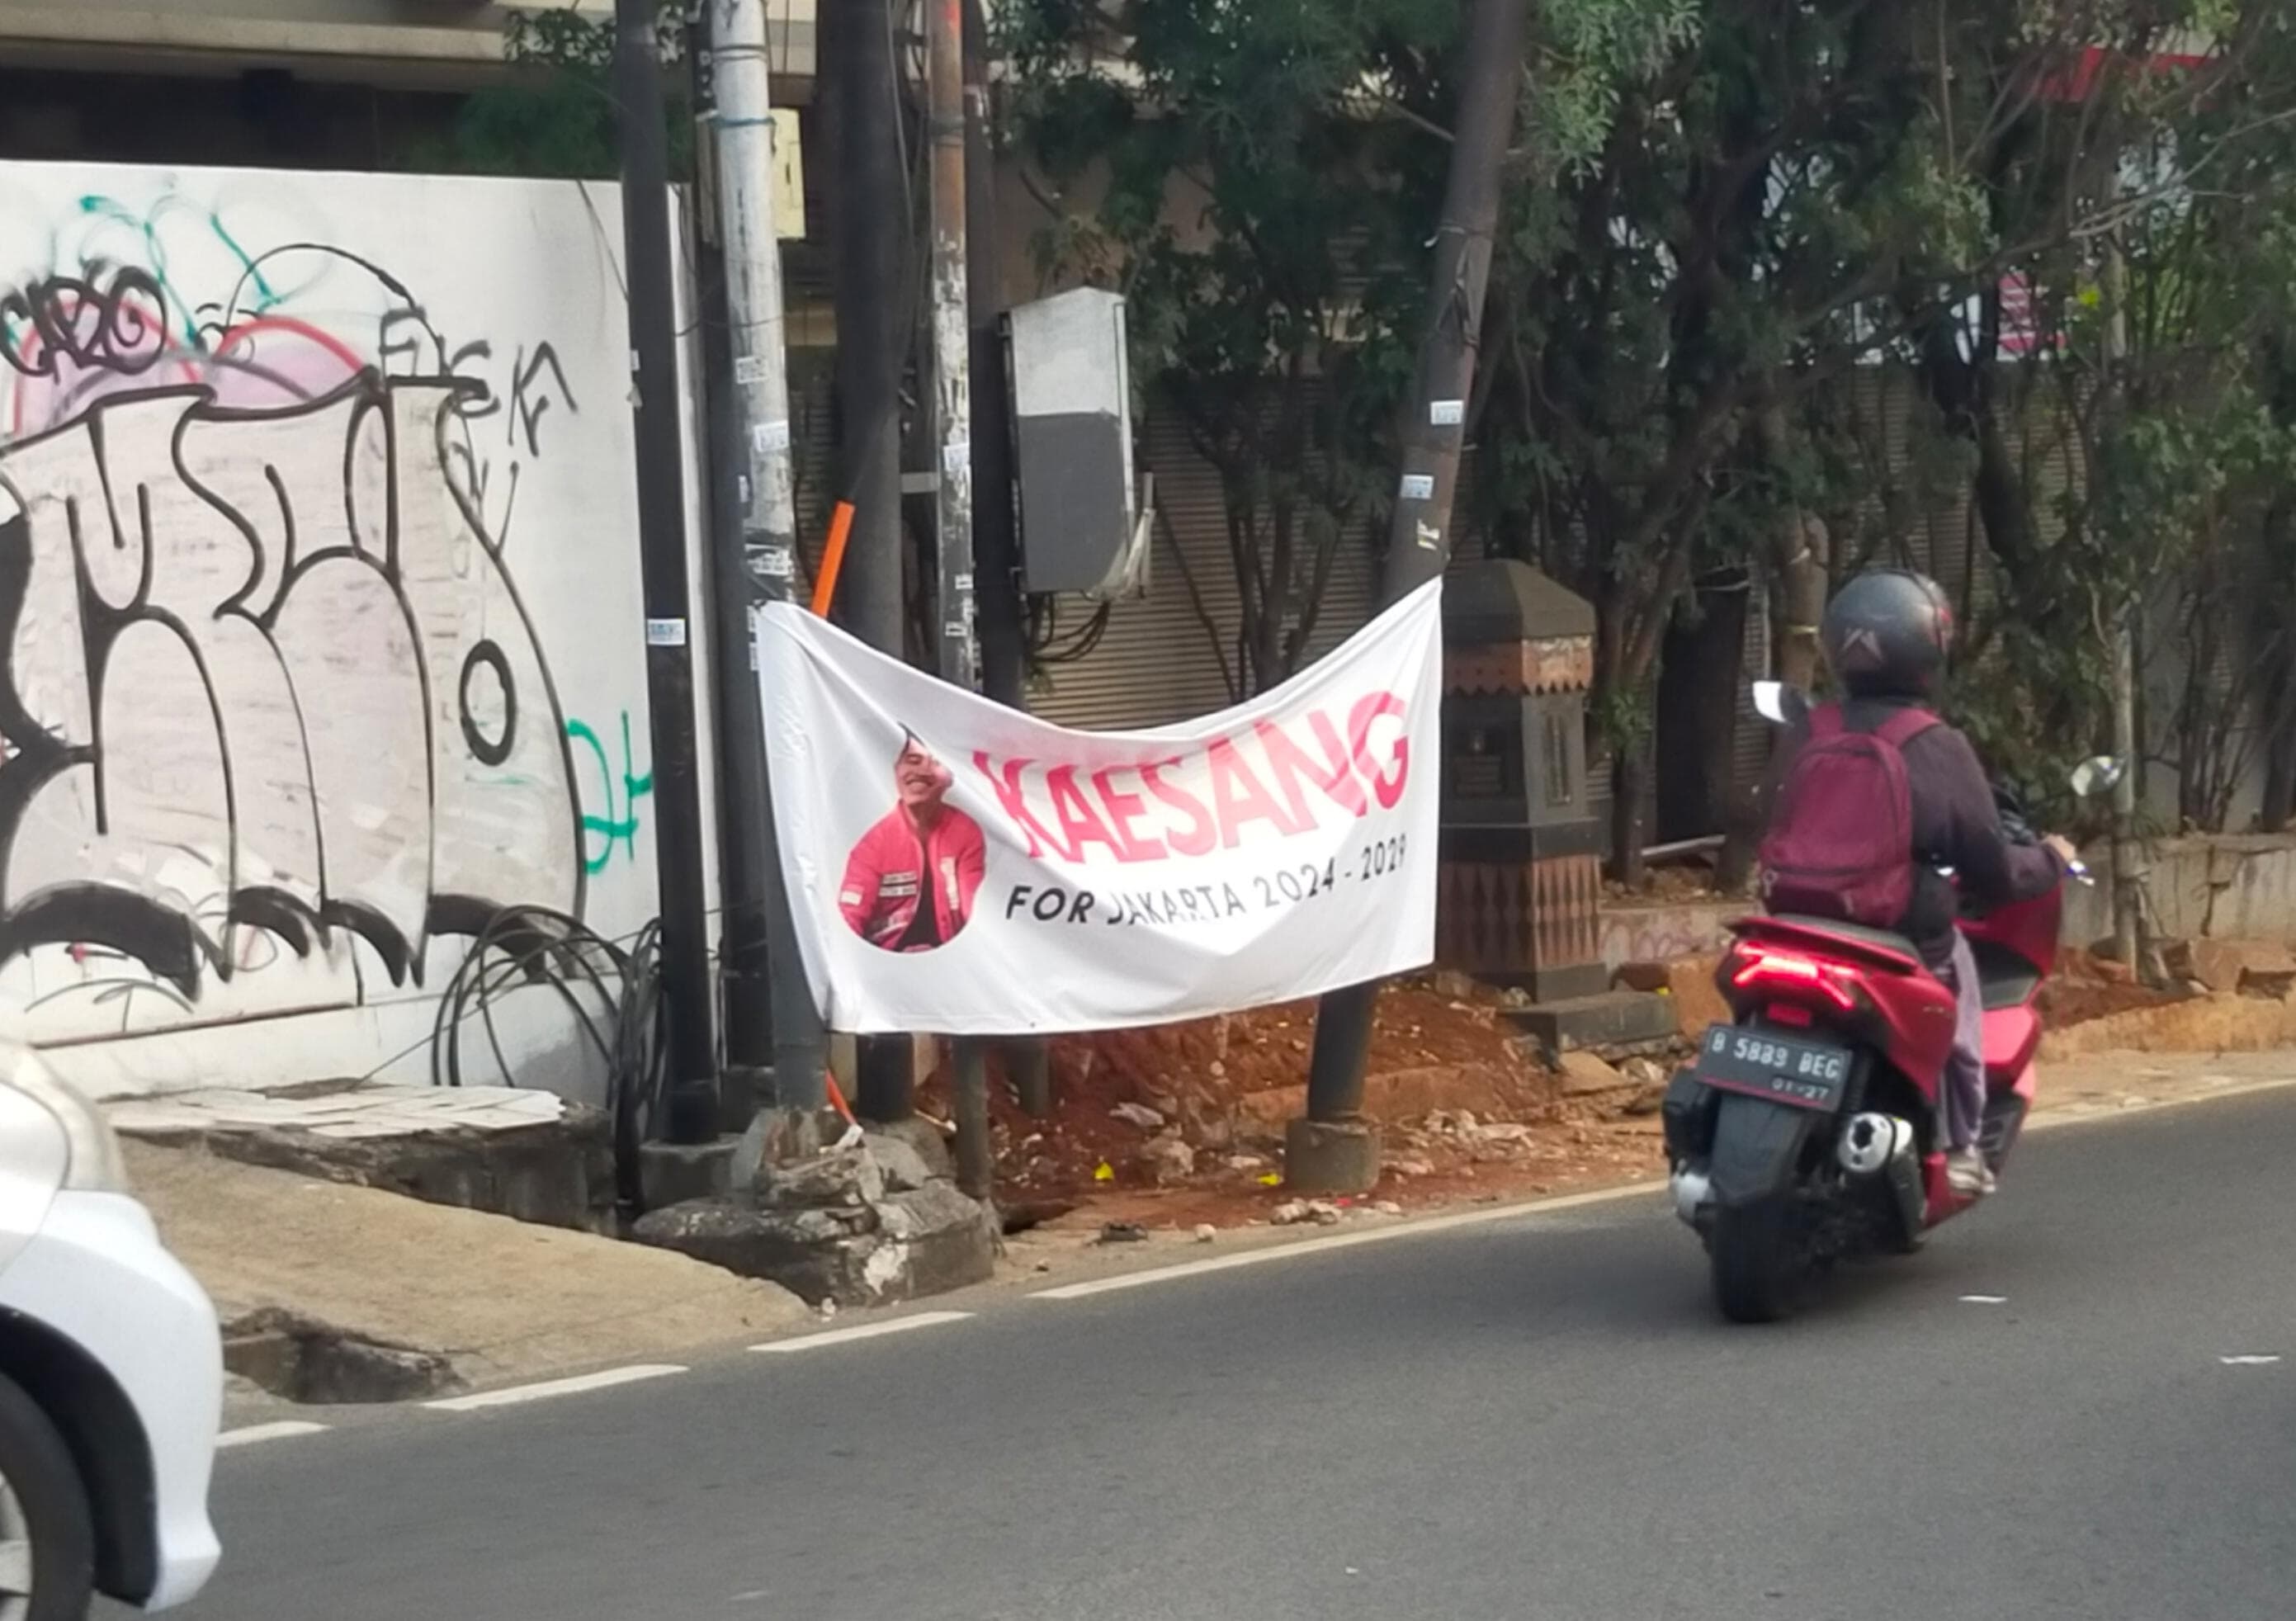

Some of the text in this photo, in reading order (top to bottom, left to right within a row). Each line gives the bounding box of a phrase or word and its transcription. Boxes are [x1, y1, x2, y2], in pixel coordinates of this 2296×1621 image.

[973, 691, 1409, 863] KAESANG
[1005, 886, 1095, 924] FOR
[1107, 881, 1247, 925] JAKARTA
[1254, 857, 1336, 909] 2024
[1359, 833, 1406, 882] 2029
[1711, 1031, 1727, 1053] B
[1798, 1051, 1840, 1080] BEG
